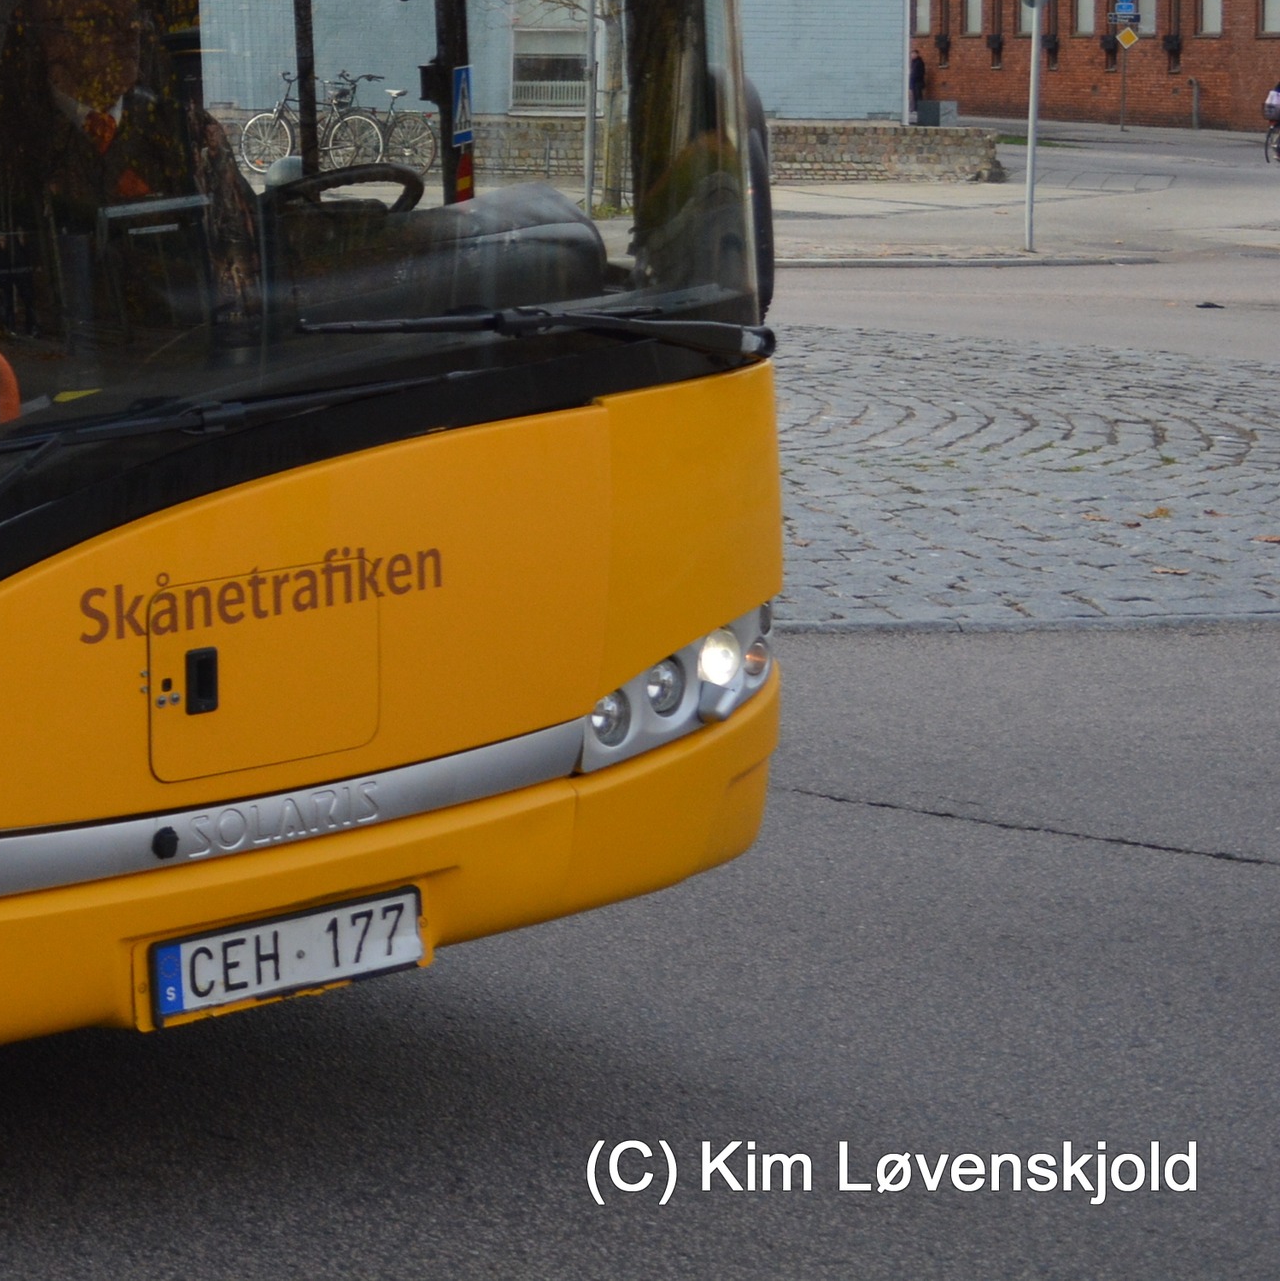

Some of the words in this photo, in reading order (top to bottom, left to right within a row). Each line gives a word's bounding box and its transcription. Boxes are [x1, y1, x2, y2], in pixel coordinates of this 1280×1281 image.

[78, 546, 443, 645] Skånetrafiken
[188, 779, 380, 859] SOLARIS
[188, 929, 281, 1000] CEH
[325, 901, 405, 968] 177
